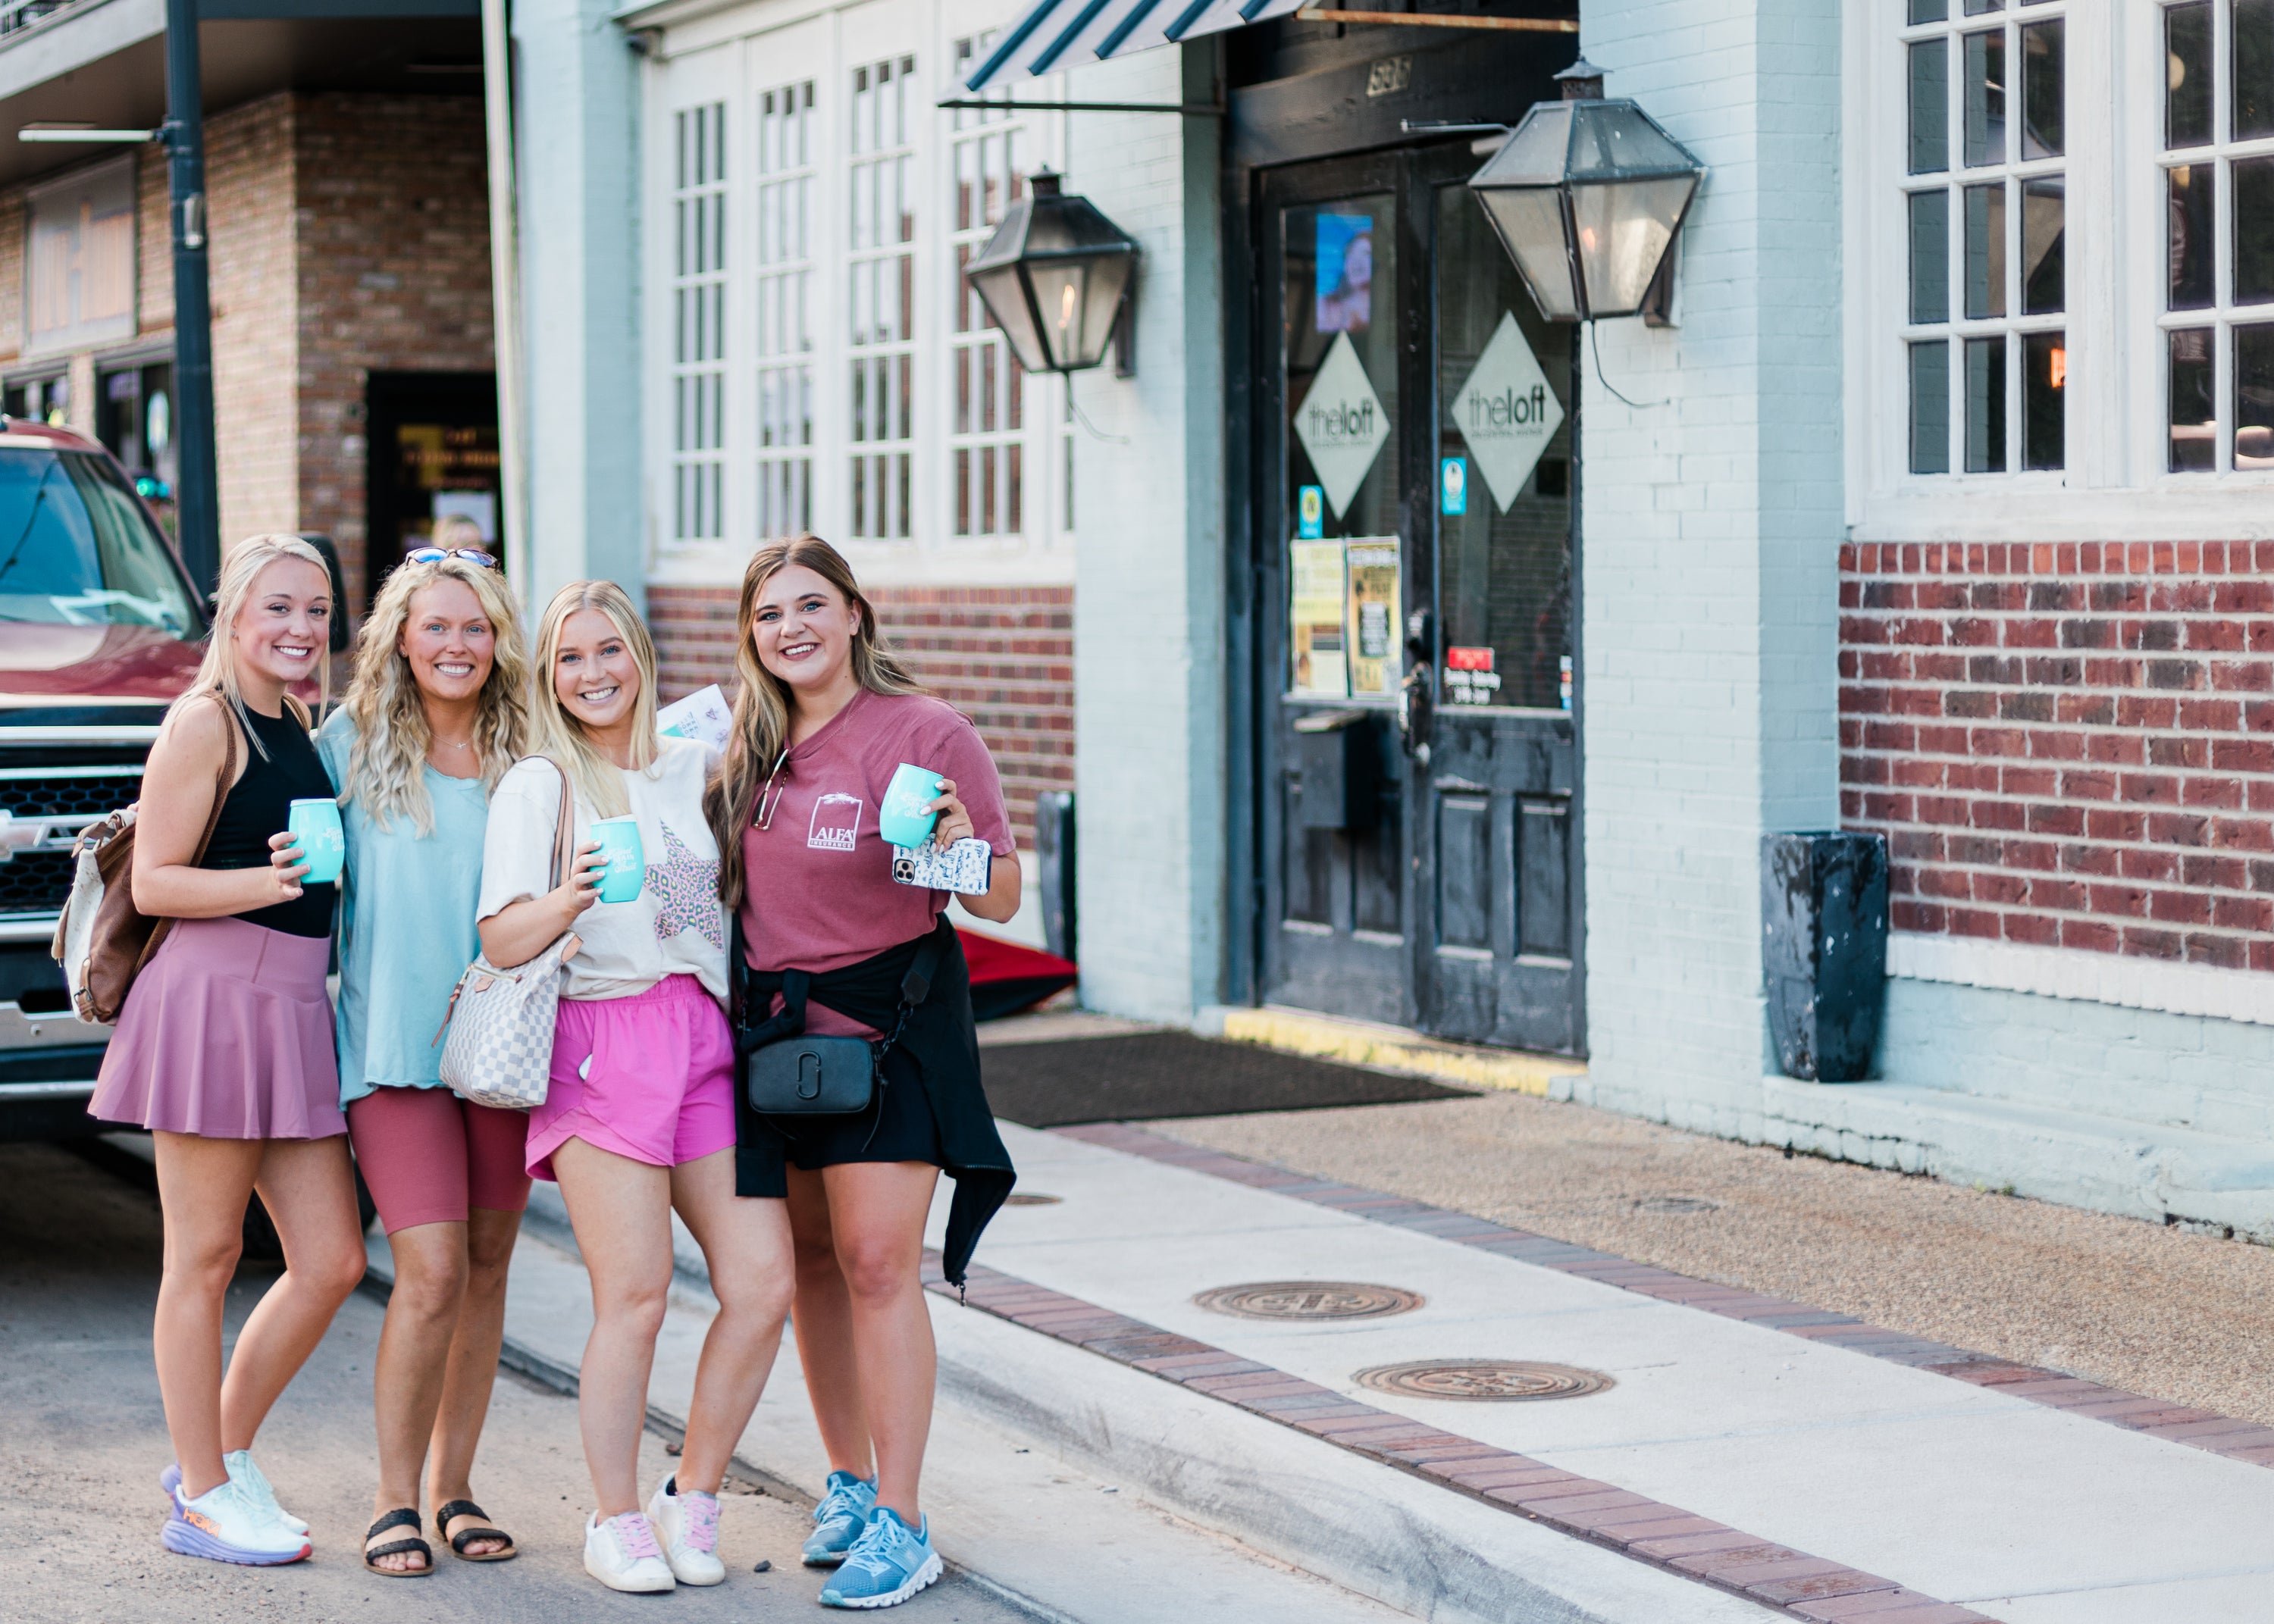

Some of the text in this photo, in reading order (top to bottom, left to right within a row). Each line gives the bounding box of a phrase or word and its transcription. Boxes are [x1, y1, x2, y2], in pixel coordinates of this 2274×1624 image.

[816, 827, 854, 842] ALFA
[810, 840, 853, 848] INSURANCE
[183, 1507, 221, 1539] HOKA
